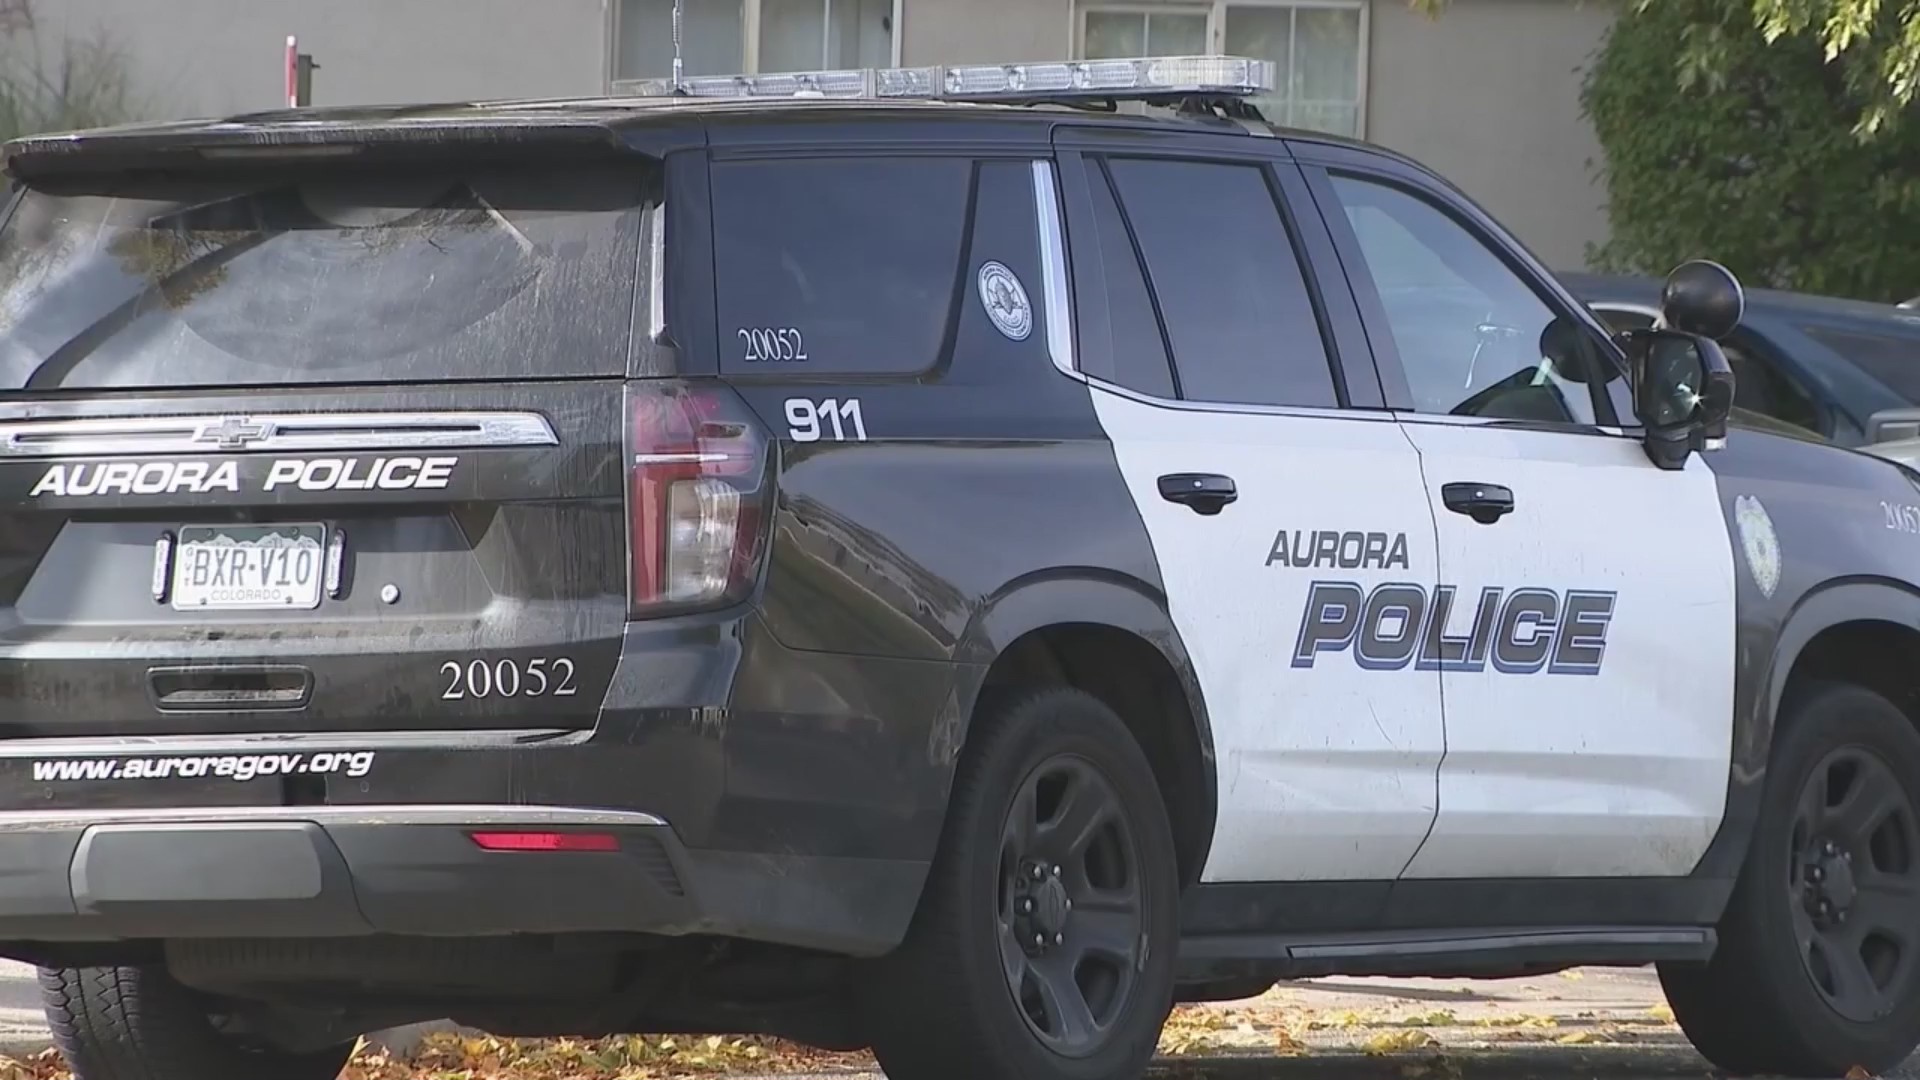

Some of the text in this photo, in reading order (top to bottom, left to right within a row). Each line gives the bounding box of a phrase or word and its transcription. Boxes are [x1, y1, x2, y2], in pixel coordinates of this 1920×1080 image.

[737, 327, 808, 361] 20052
[784, 398, 867, 442] 911
[30, 456, 457, 497] AURORA POLICE
[1265, 530, 1409, 570] AURORA
[210, 589, 282, 601] COLORADO
[1290, 580, 1618, 676] POLICE
[439, 657, 577, 700] 20052
[32, 750, 375, 782] www.auroragov.org
